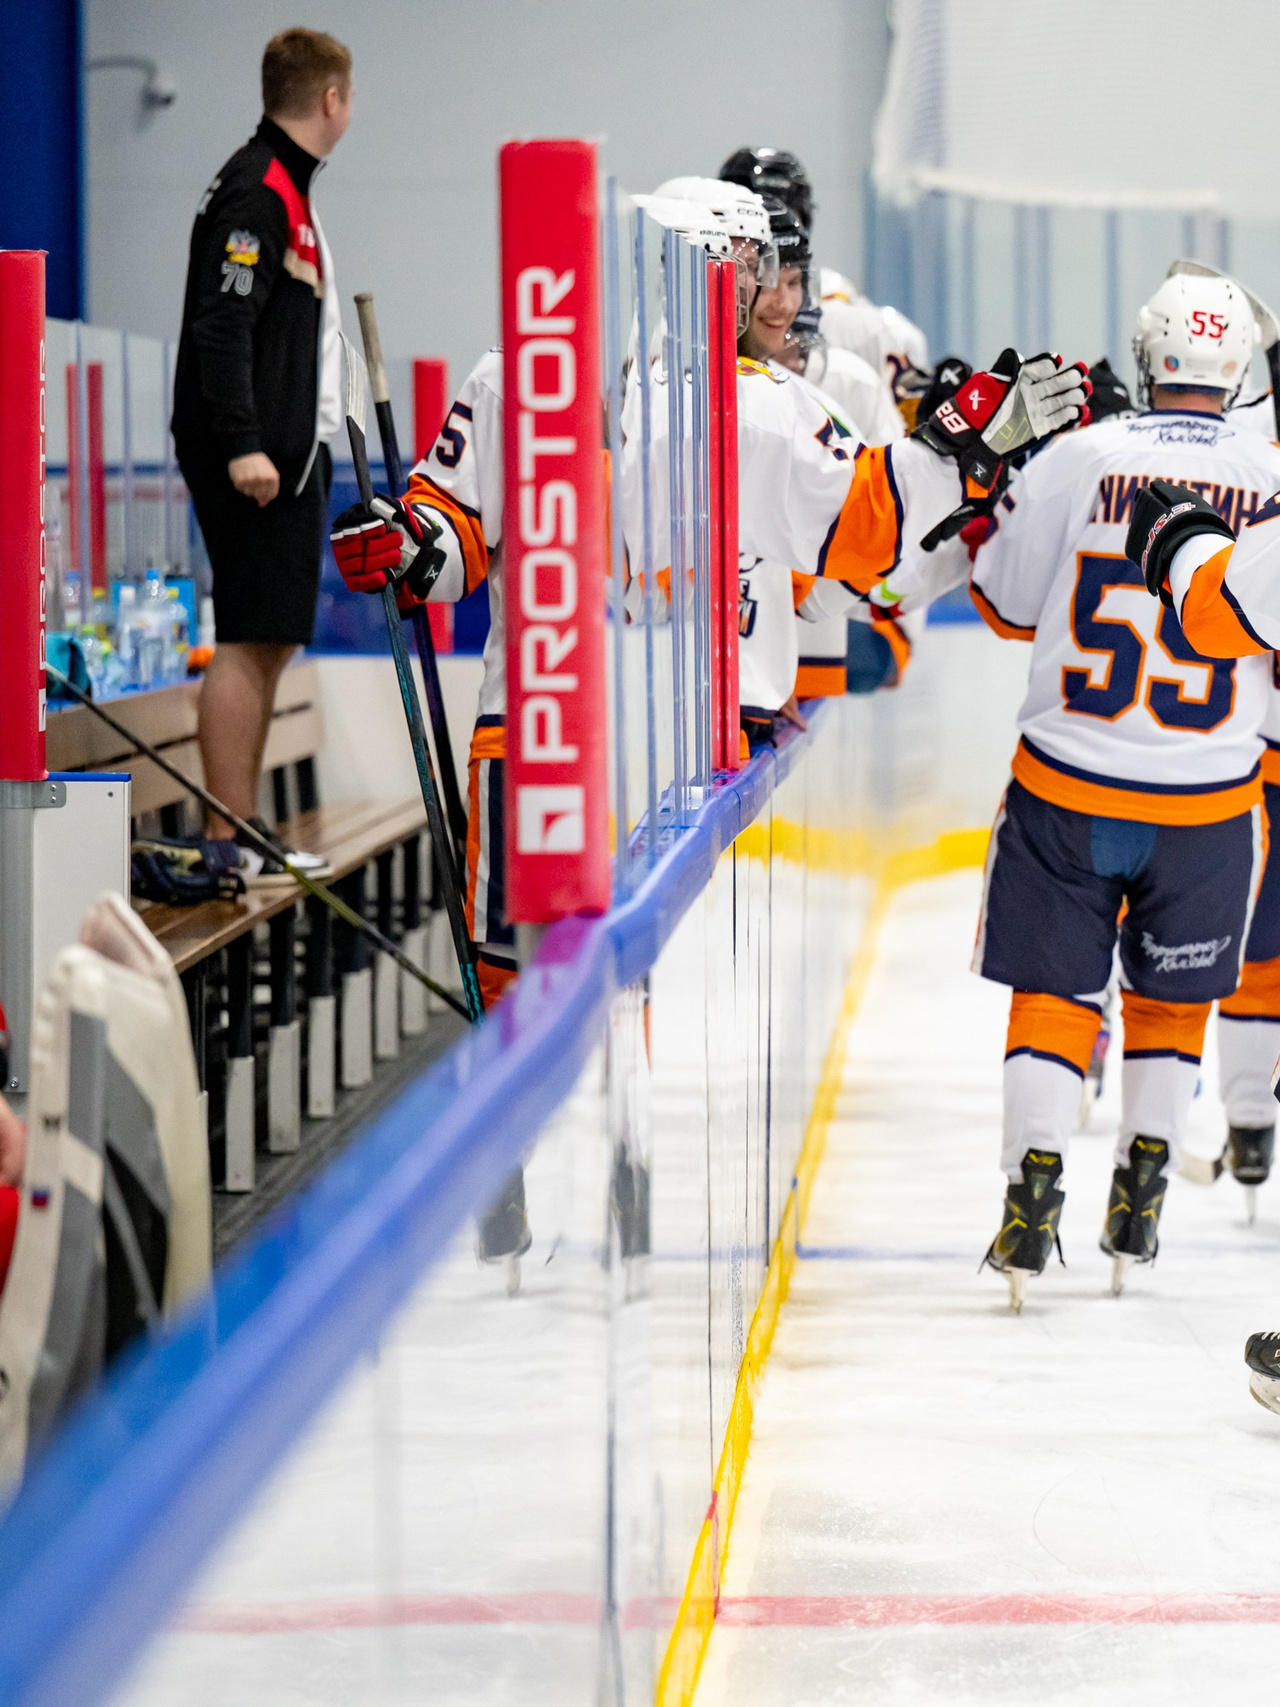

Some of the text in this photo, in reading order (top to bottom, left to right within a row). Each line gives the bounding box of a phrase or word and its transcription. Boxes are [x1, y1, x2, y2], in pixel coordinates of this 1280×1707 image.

[220, 261, 255, 296] 70
[1190, 310, 1225, 339] 55
[516, 266, 581, 763] PROSTOR
